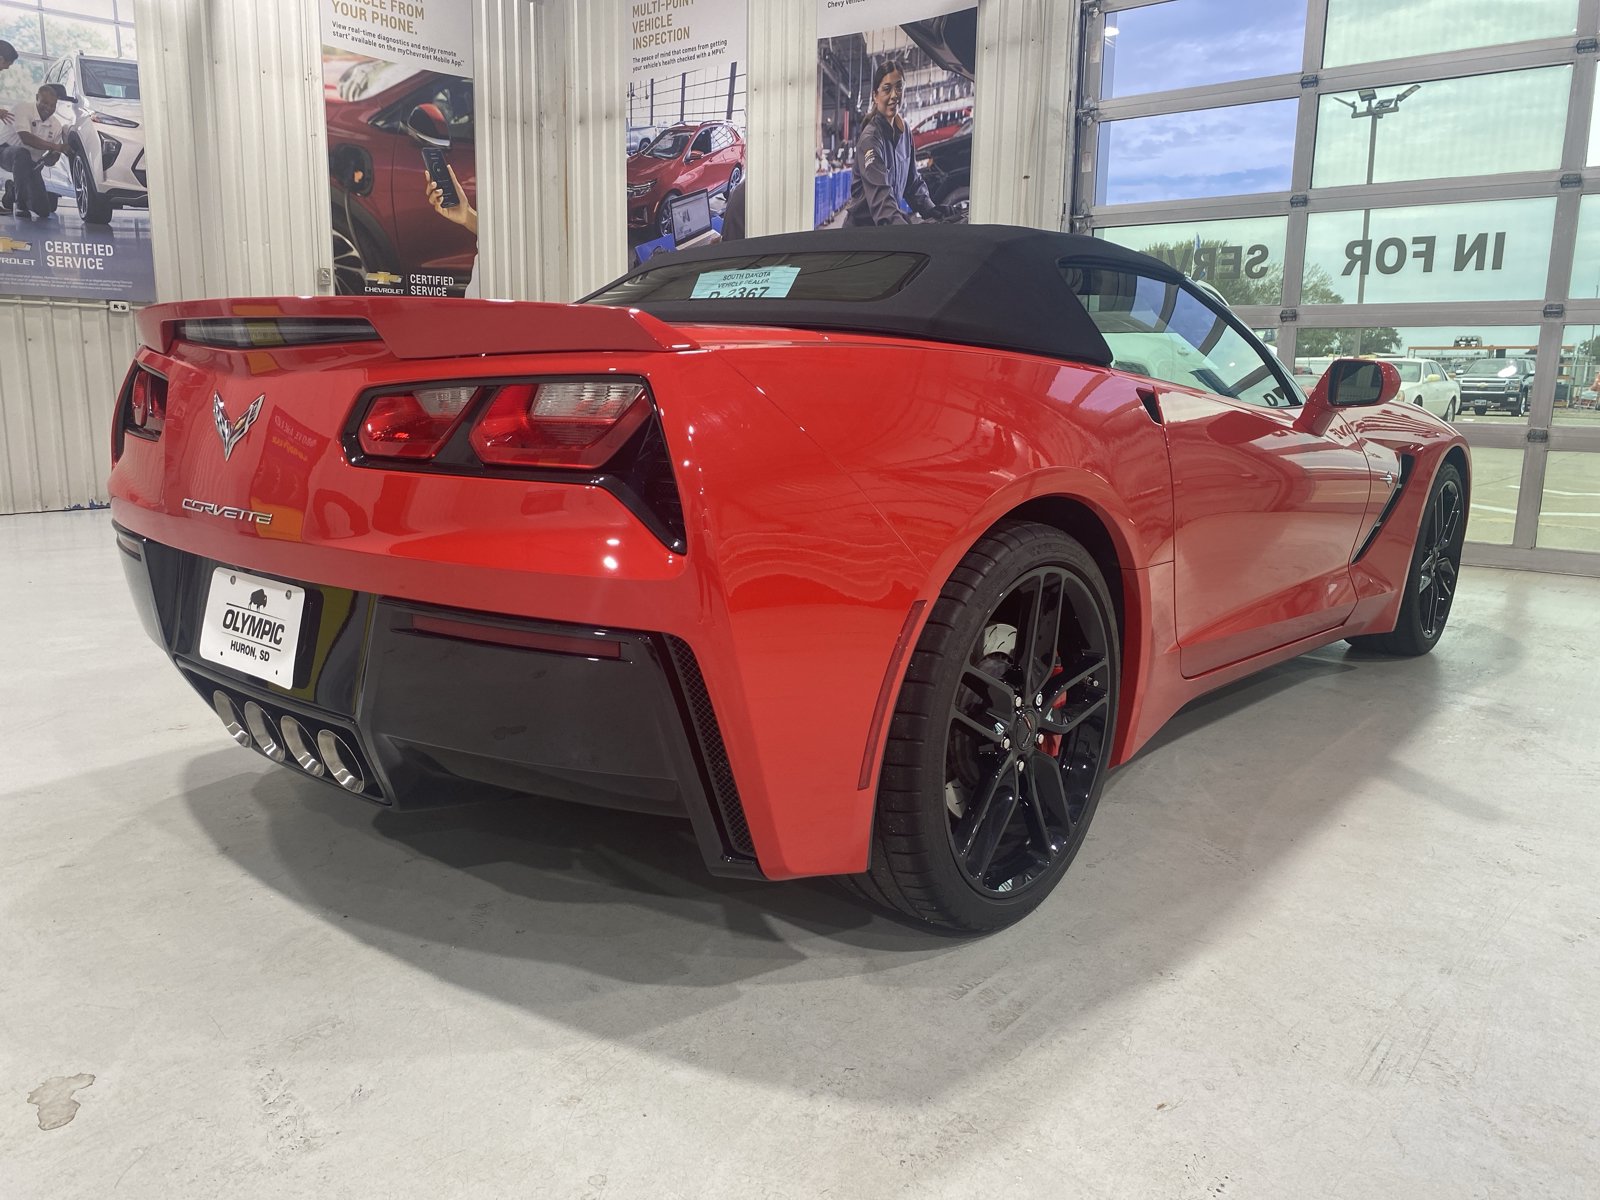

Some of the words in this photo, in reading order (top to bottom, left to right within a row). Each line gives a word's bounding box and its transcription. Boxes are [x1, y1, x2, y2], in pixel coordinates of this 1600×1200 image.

[331, 0, 368, 21] YOUR
[371, 10, 418, 35] PHONE.
[390, 0, 425, 20] FROM
[632, 14, 673, 34] VEHICLE
[332, 20, 347, 30] View
[348, 26, 377, 38] real-time
[377, 33, 410, 47] diagnostics
[410, 42, 421, 50] and
[422, 45, 436, 54] enjoy
[437, 48, 457, 57] remote
[632, 26, 690, 50] INSPECTION
[351, 35, 377, 47] available
[386, 44, 396, 52] the
[433, 55, 450, 64] Mobile
[641, 55, 654, 63] peace
[682, 46, 697, 54] comes
[710, 39, 728, 49] getting
[632, 65, 643, 73] your
[662, 58, 676, 66] health
[677, 53, 696, 63] checked
[696, 51, 707, 59] with
[45, 240, 114, 257] CERTIFIED
[46, 255, 105, 270] SERVICE
[409, 274, 454, 286] CERTIFIED
[722, 273, 744, 281] SOUTH
[744, 271, 771, 279] DAKOTA
[364, 286, 404, 294] CHEVROLET
[410, 285, 448, 297] SERVICE
[182, 498, 273, 525] CORVETTE
[222, 608, 285, 646] OLYMPIC
[230, 639, 257, 660] HURON,
[259, 649, 270, 662] SD
